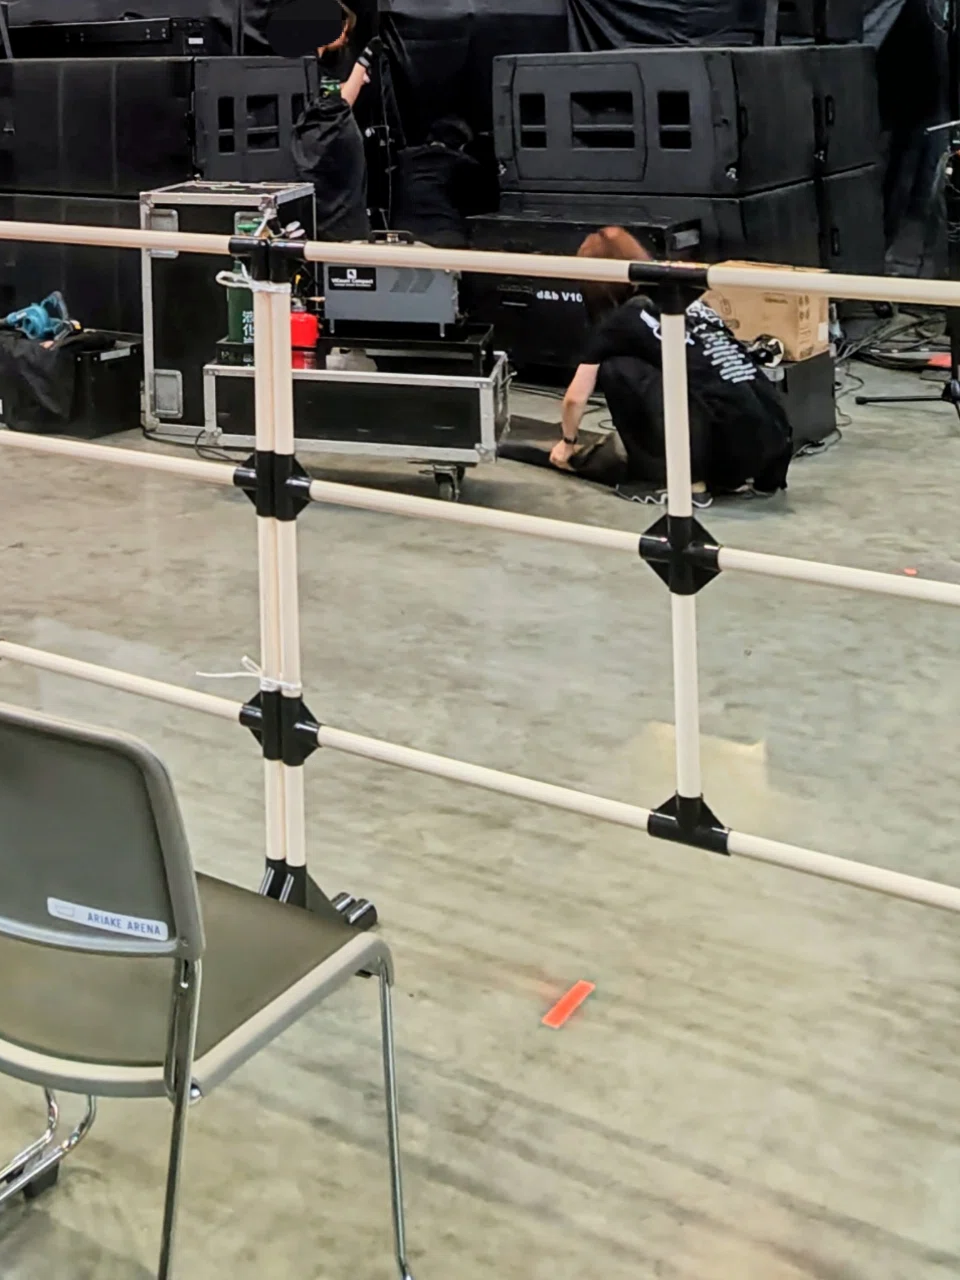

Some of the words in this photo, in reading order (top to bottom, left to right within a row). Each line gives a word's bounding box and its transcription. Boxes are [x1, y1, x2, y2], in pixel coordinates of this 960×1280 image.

[536, 290, 559, 301] d&b
[87, 912, 122, 929] ARIAKE
[127, 920, 161, 935] ARENA
